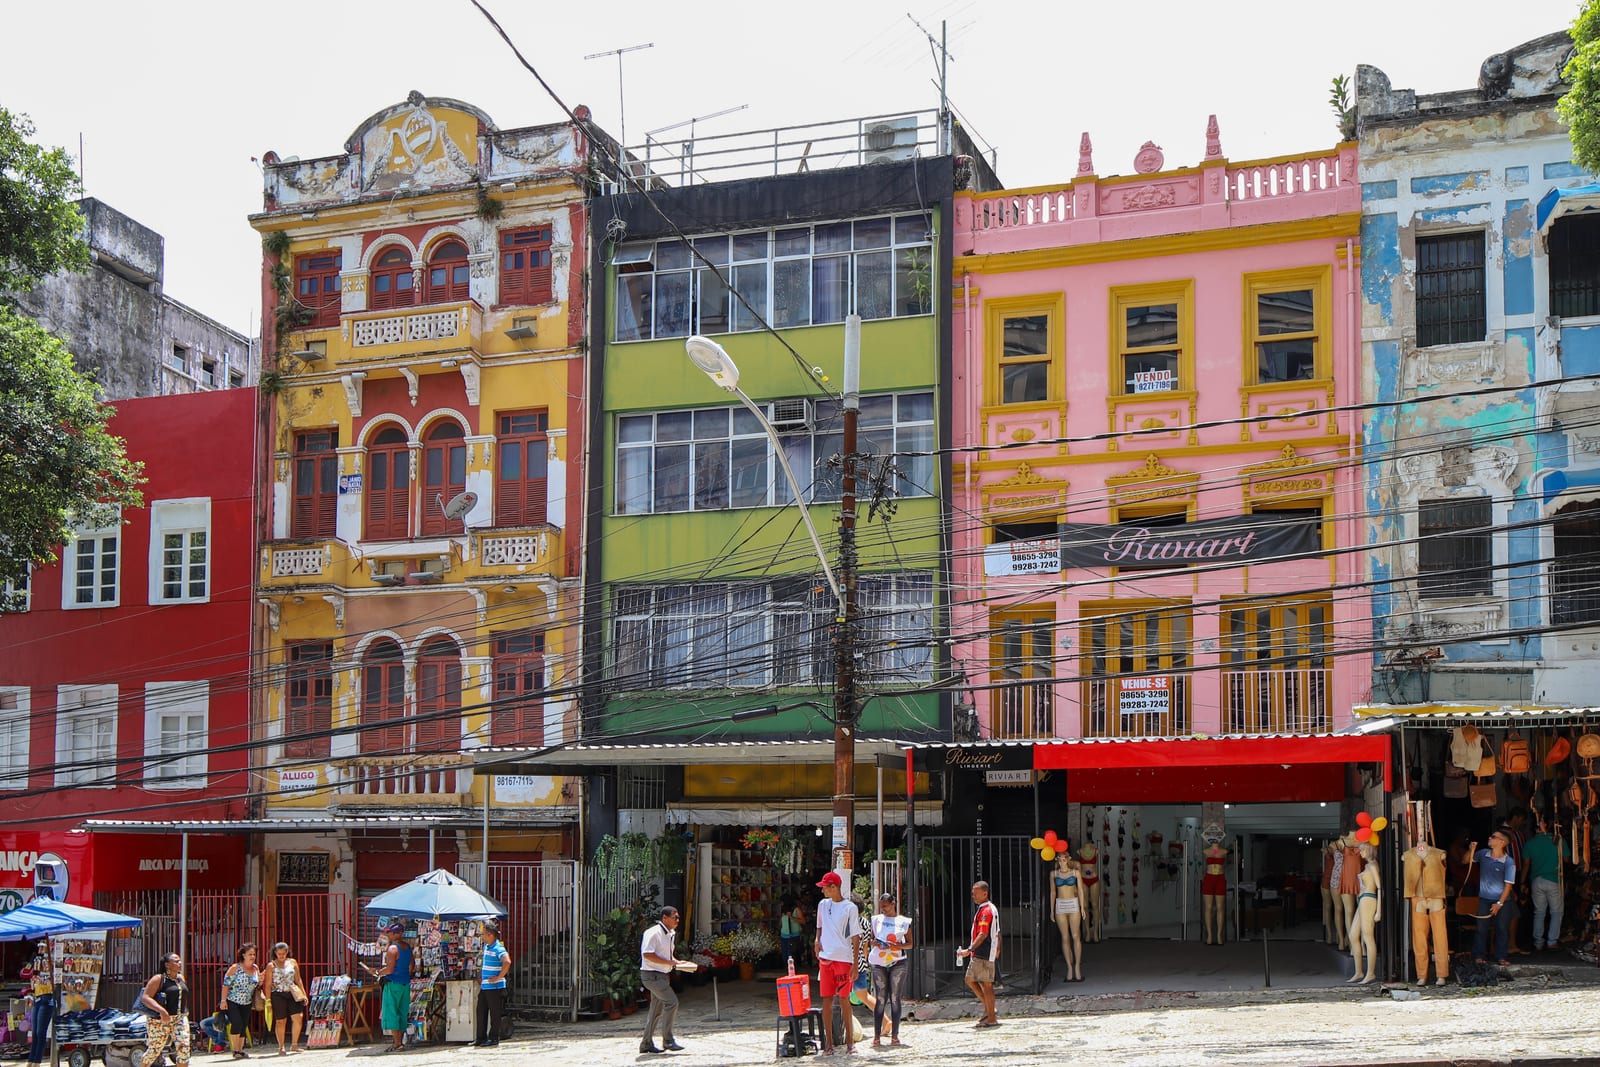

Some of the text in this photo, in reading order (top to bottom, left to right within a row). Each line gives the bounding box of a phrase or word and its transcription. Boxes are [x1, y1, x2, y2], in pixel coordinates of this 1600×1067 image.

[1136, 371, 1170, 382] VENDO
[1103, 527, 1258, 562] Riviart
[1012, 552, 1058, 562] 98655-3290
[1012, 561, 1058, 570] 99283-7242
[1121, 677, 1167, 689] VENDE-SE
[1120, 690, 1168, 699] 98655-3290
[1120, 700, 1169, 709] 99283-7242
[945, 748, 1002, 765] Riviart
[282, 771, 315, 780] ALUGO
[496, 776, 534, 786] 98167-7115
[139, 859, 163, 871] ARCA
